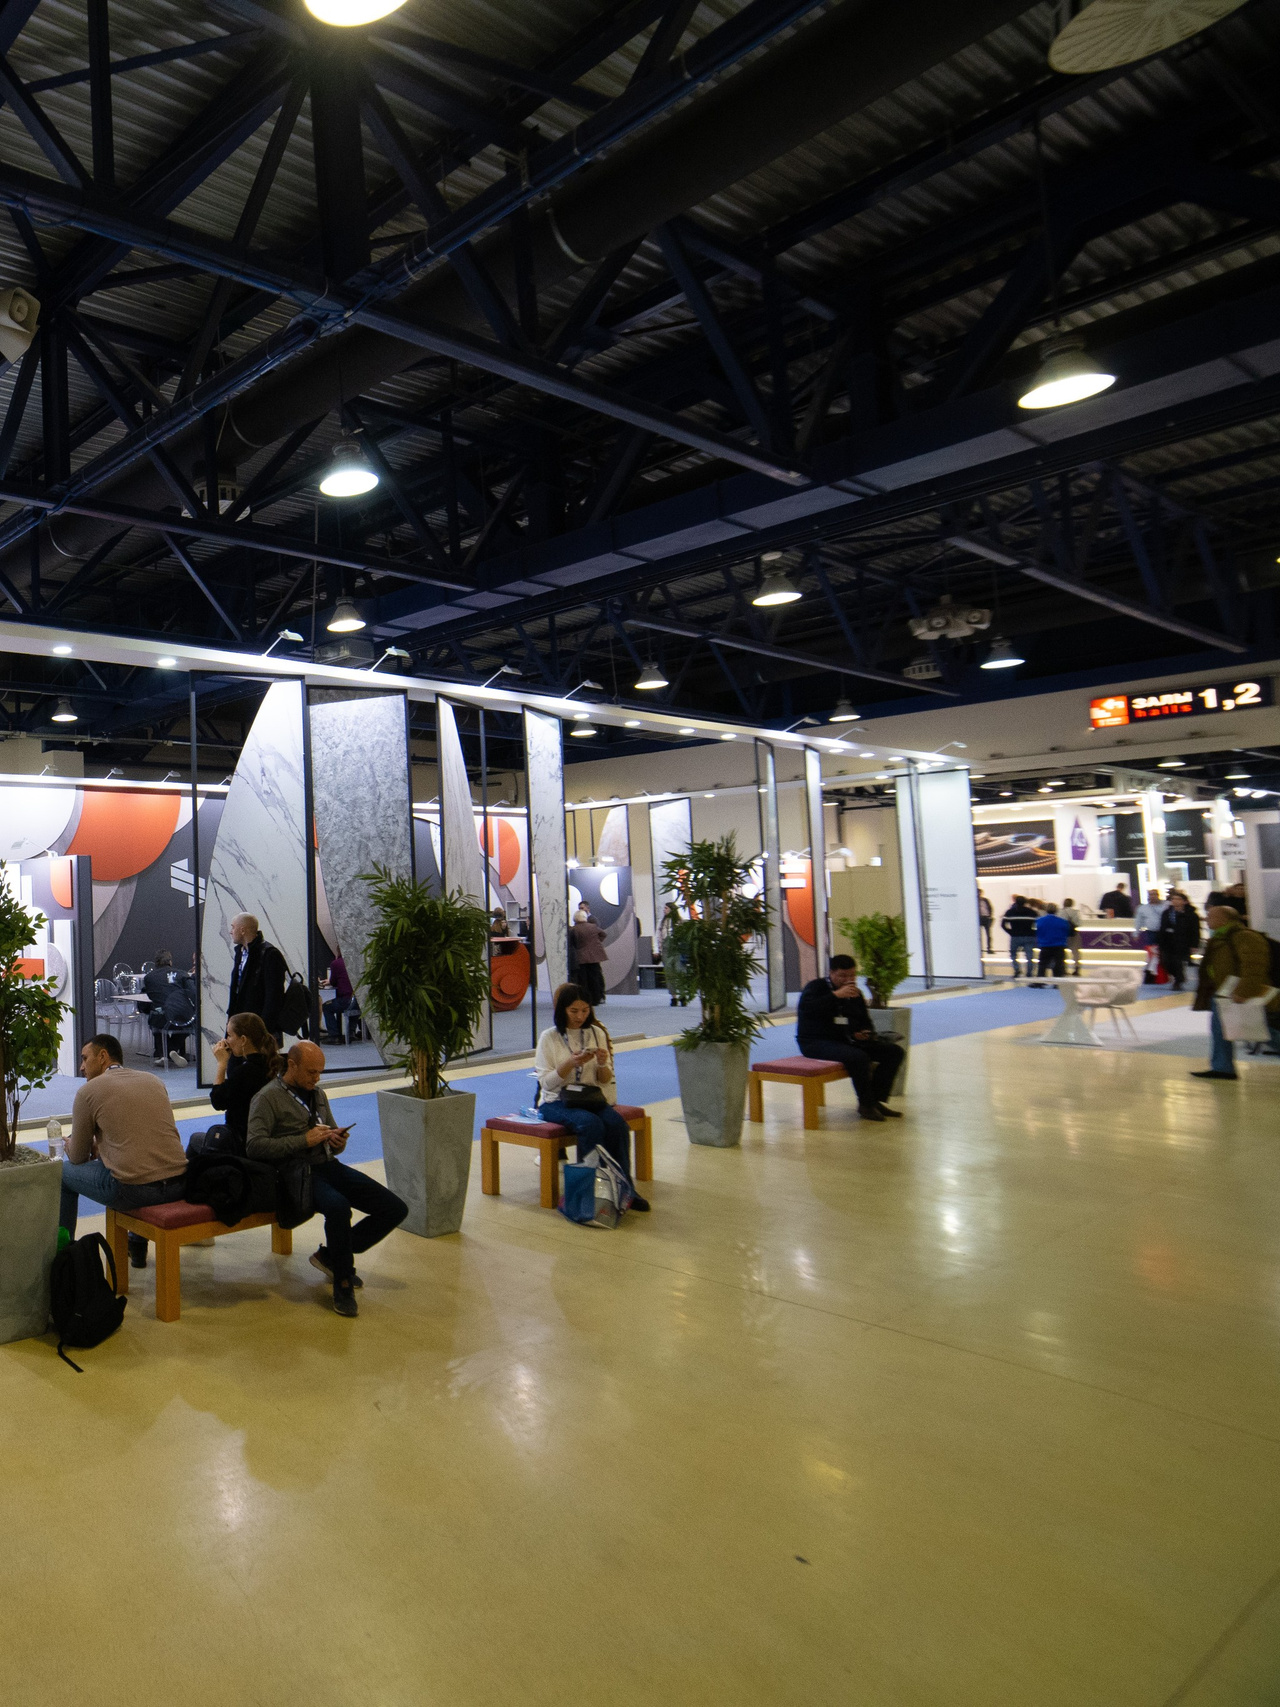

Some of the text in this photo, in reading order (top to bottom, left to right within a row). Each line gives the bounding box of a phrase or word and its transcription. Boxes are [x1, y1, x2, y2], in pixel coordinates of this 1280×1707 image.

[1132, 683, 1262, 711] ЗАЛЫ 1,2
[1134, 704, 1193, 718] halls
